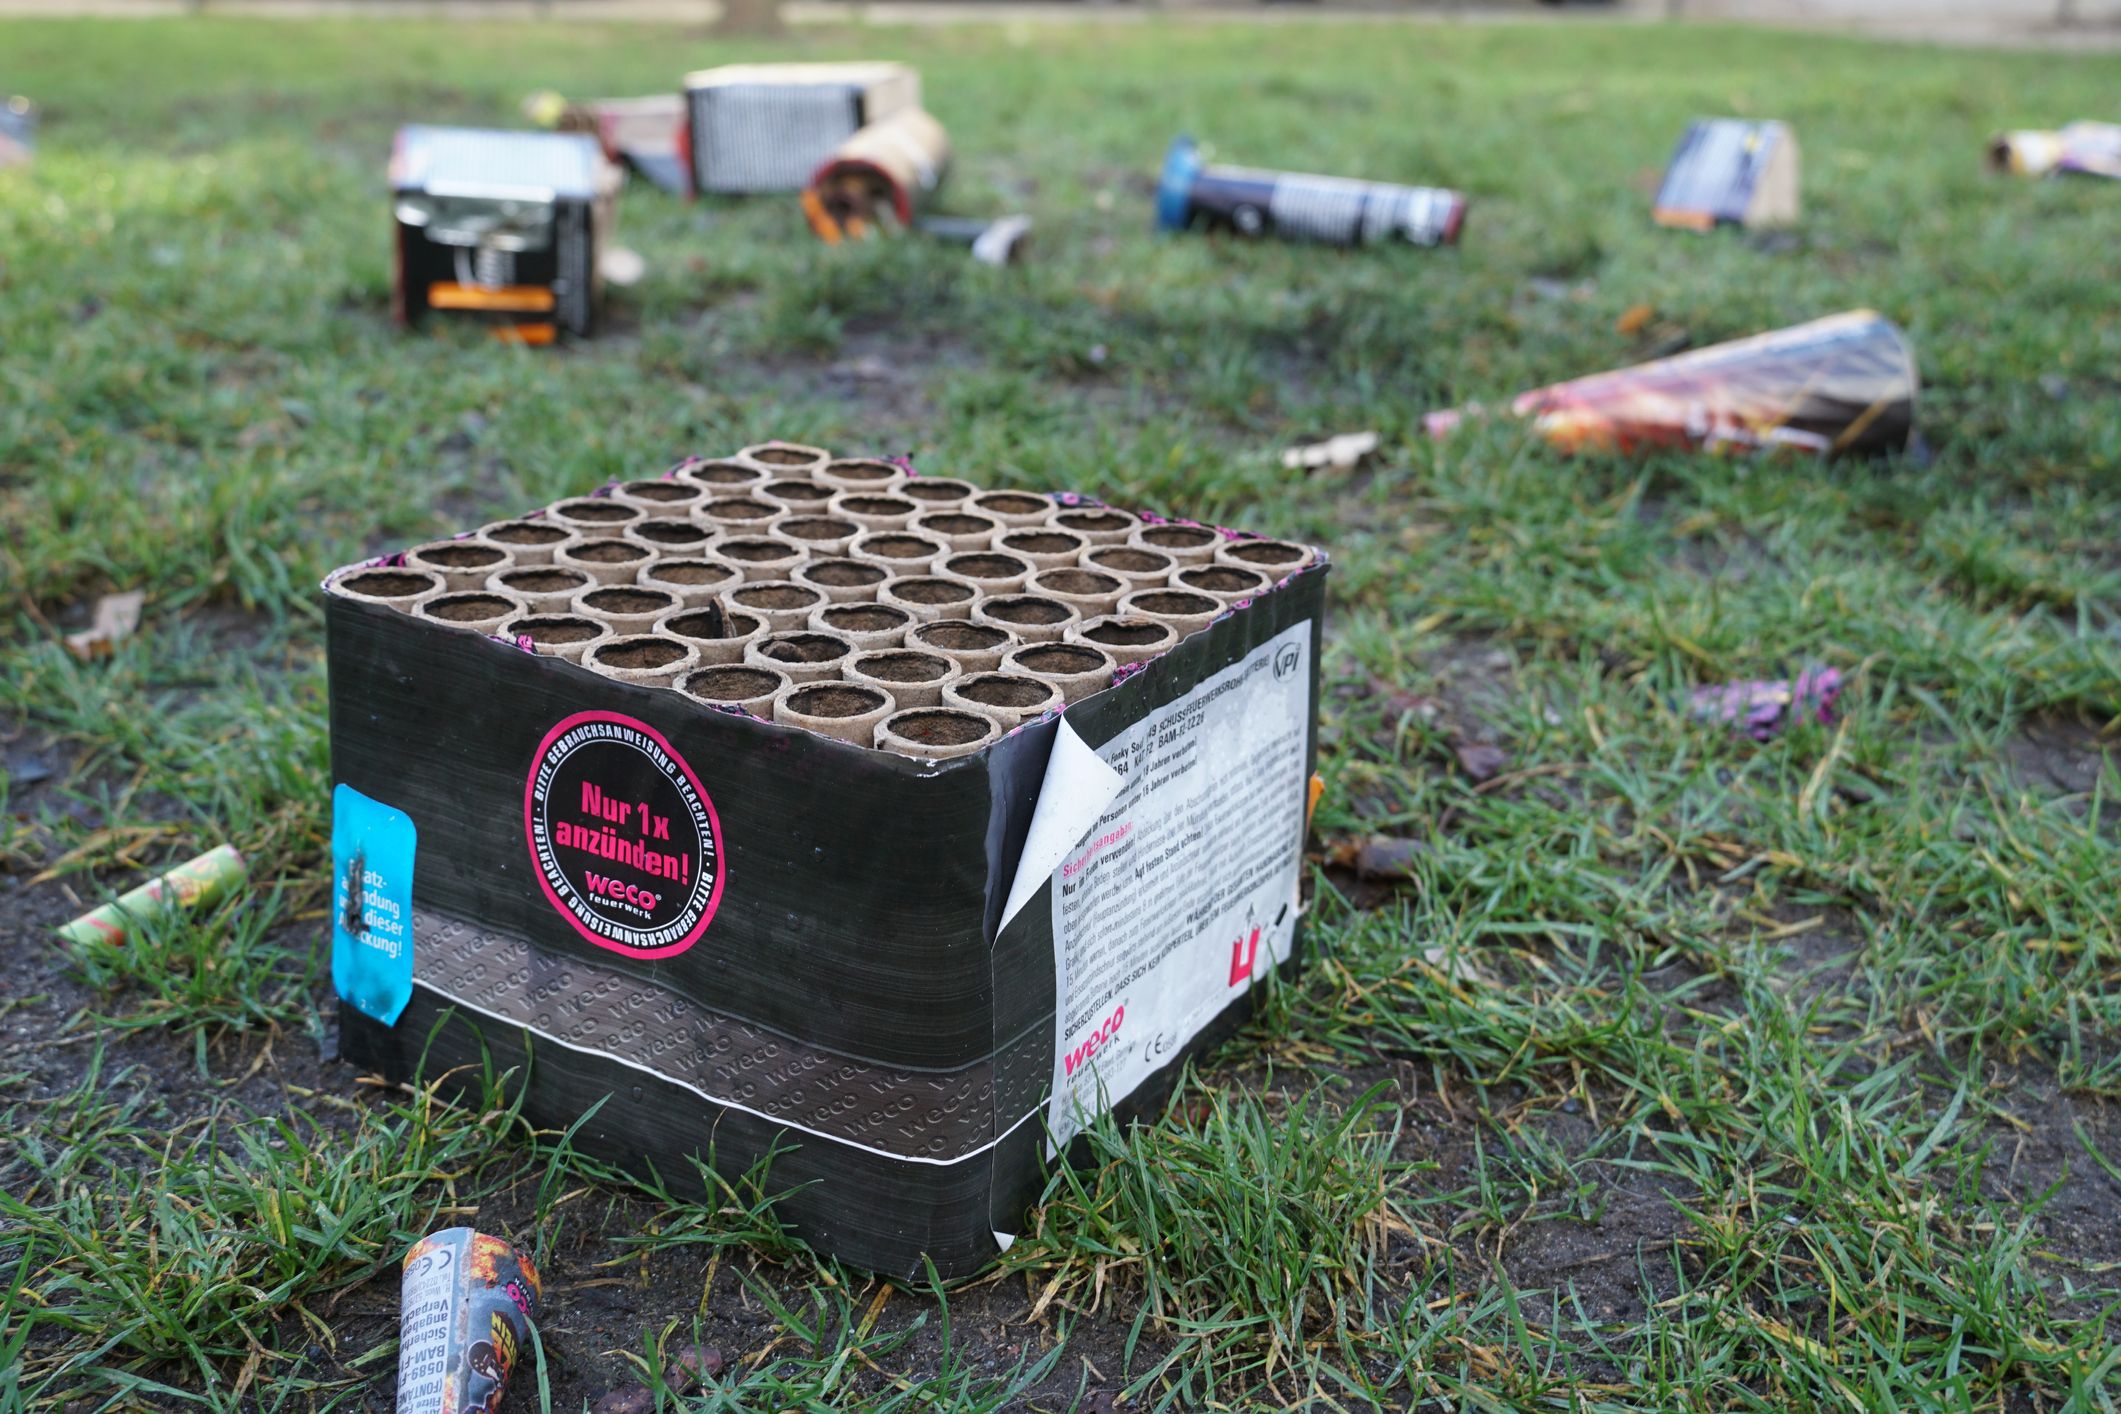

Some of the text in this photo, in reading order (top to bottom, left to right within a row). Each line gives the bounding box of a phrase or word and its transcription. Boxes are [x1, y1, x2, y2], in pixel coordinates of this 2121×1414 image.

[1150, 755, 1170, 771] Jahren
[534, 724, 714, 857] BITTE GEBRAUCHSANWEISUNG BEACHTEN!
[581, 781, 631, 825] Nur
[1099, 804, 1127, 825] Personen
[1150, 774, 1169, 791] Jahren
[555, 821, 689, 886] anzünden!
[1164, 841, 1179, 859] Stand
[533, 817, 713, 946] BITTE GEBRAUCHSANWEISUNG BEACHTEN!
[585, 870, 657, 910] weco
[1062, 883, 1075, 897] Nur
[364, 908, 404, 936] dieser
[589, 893, 652, 920] feuerwerk
[452, 930, 504, 962] wec
[475, 966, 529, 1006] weco
[518, 972, 573, 1010] weco
[1131, 964, 1145, 981] SICH
[558, 975, 622, 1017] weco
[630, 1027, 689, 1065] weco
[674, 1035, 732, 1072] weco
[716, 1041, 781, 1079] weco
[1064, 1004, 1125, 1077] weco
[844, 1093, 918, 1136] weco
[899, 1078, 974, 1138] weco
